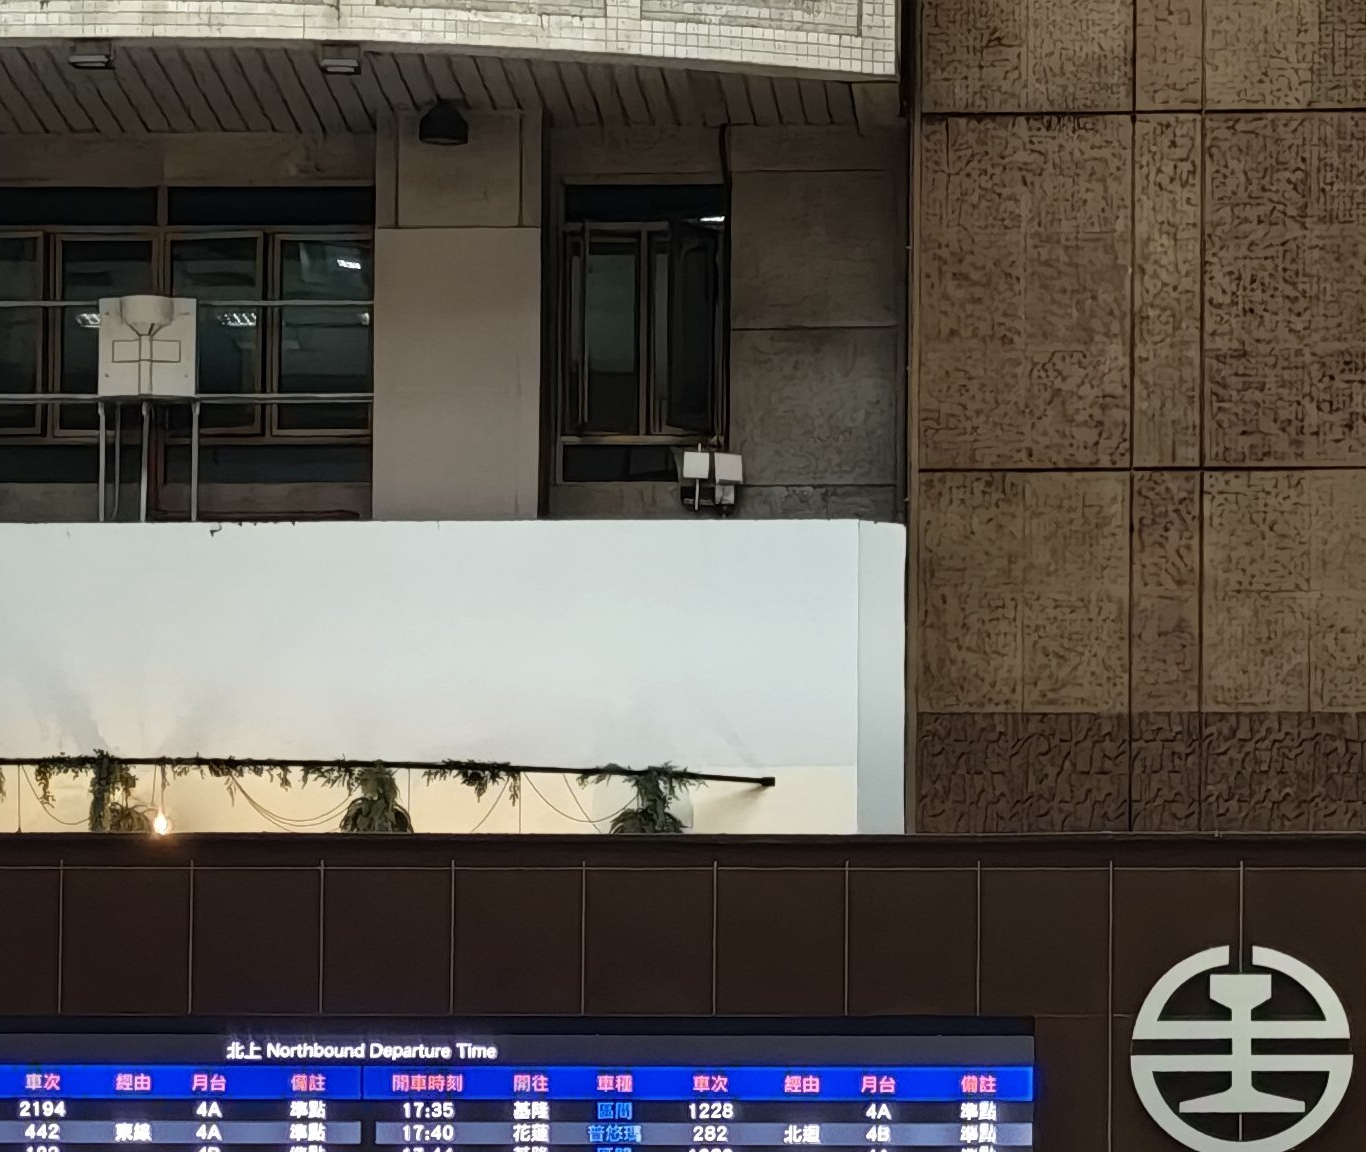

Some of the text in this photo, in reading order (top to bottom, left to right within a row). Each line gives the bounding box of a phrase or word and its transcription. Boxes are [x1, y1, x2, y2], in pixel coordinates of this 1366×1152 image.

[226, 1041, 498, 1061] 北上 Northbound Departure Time
[25, 1073, 61, 1091] 車次
[192, 1073, 226, 1092] 月台
[392, 1074, 463, 1092] 開車時刻
[513, 1074, 548, 1092] 開往
[692, 1074, 728, 1093] 車次
[784, 1074, 820, 1093] 經由
[861, 1075, 896, 1094] 月台
[19, 1100, 66, 1117] 2194
[196, 1101, 222, 1118] 4A
[403, 1102, 454, 1118] 17:35
[689, 1102, 734, 1119] 1228
[865, 1103, 892, 1120] 4A
[24, 1123, 60, 1140] 442
[195, 1123, 222, 1141] 4A
[402, 1124, 454, 1142] 17:40
[693, 1125, 728, 1142] 282
[865, 1124, 891, 1142] 4B
